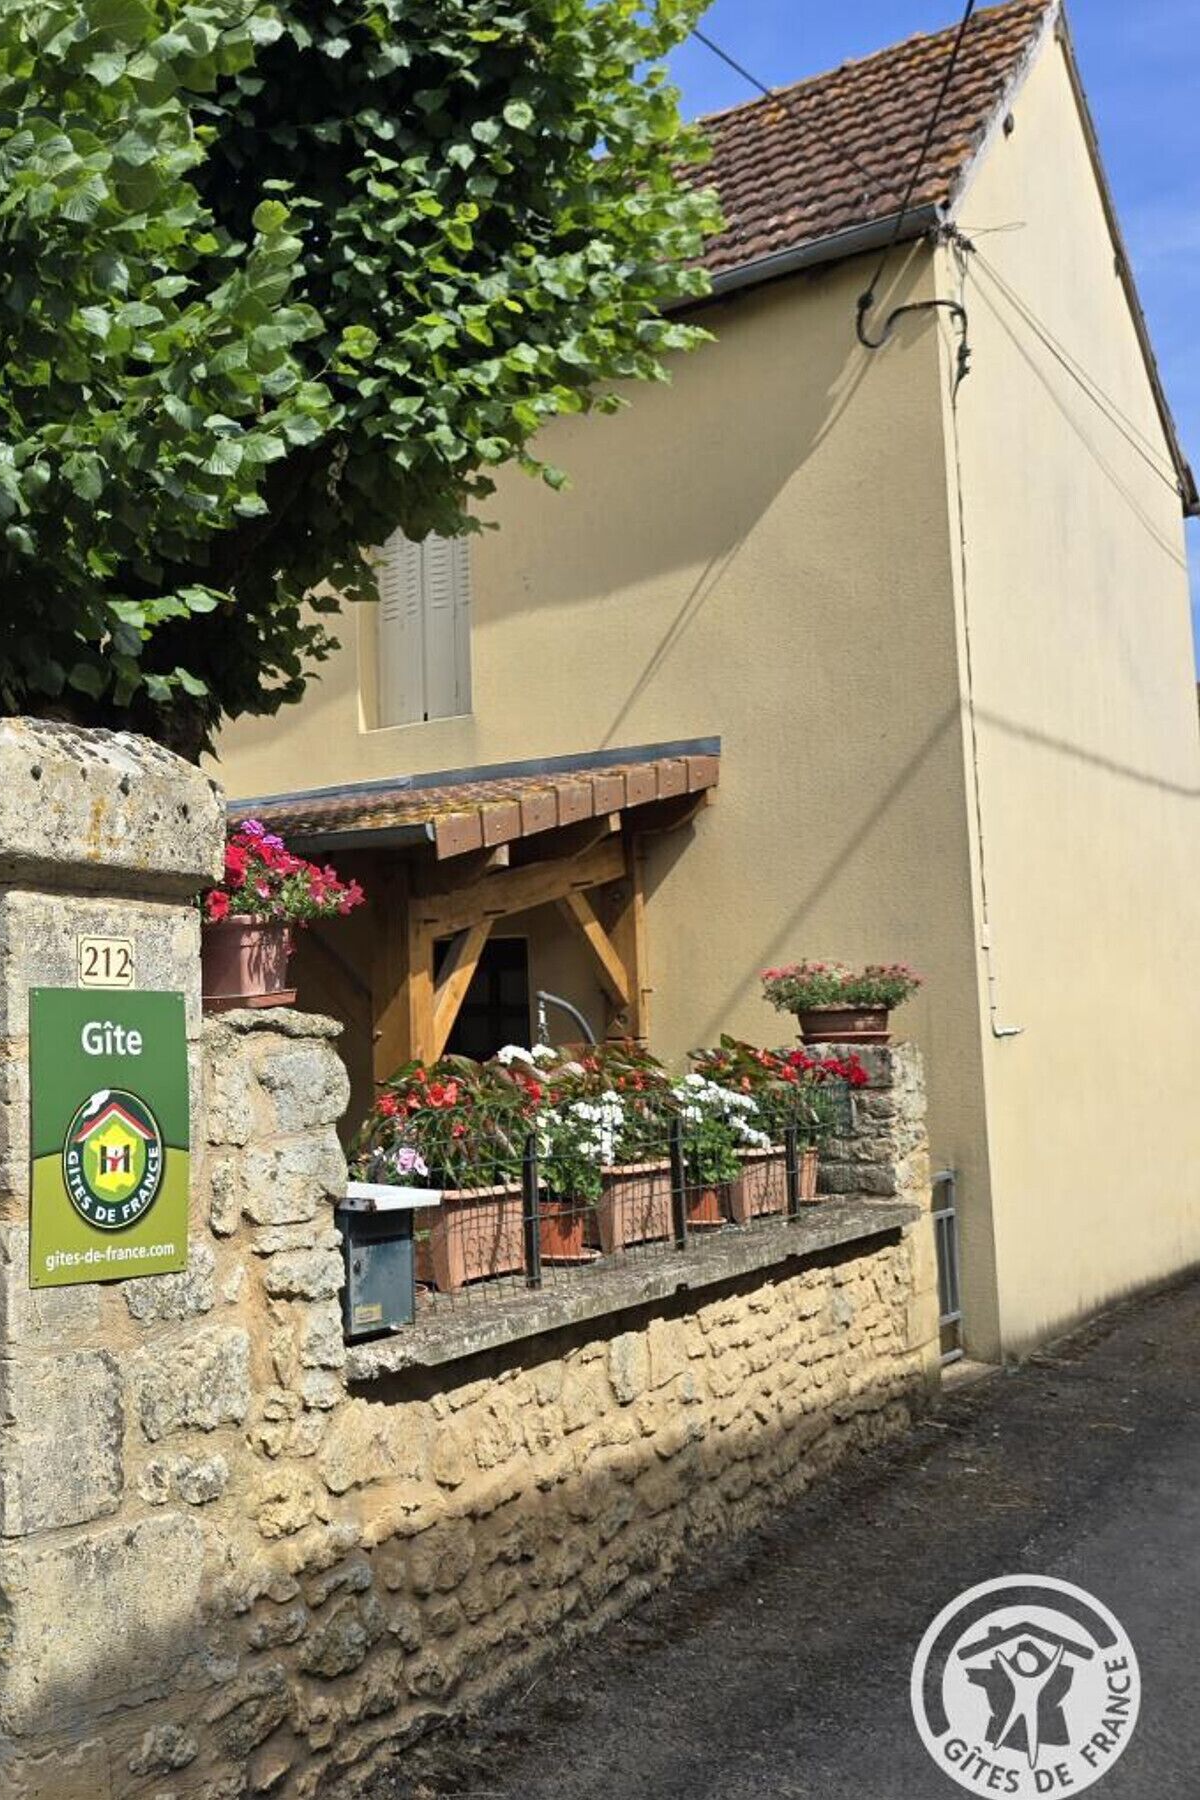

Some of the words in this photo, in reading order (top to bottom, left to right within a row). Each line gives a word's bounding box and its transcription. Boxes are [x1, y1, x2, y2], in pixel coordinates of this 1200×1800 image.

[84, 946, 130, 978] 212
[81, 1021, 143, 1056] Gîte
[95, 1206, 116, 1222] DE
[121, 1147, 159, 1219] FRANCE
